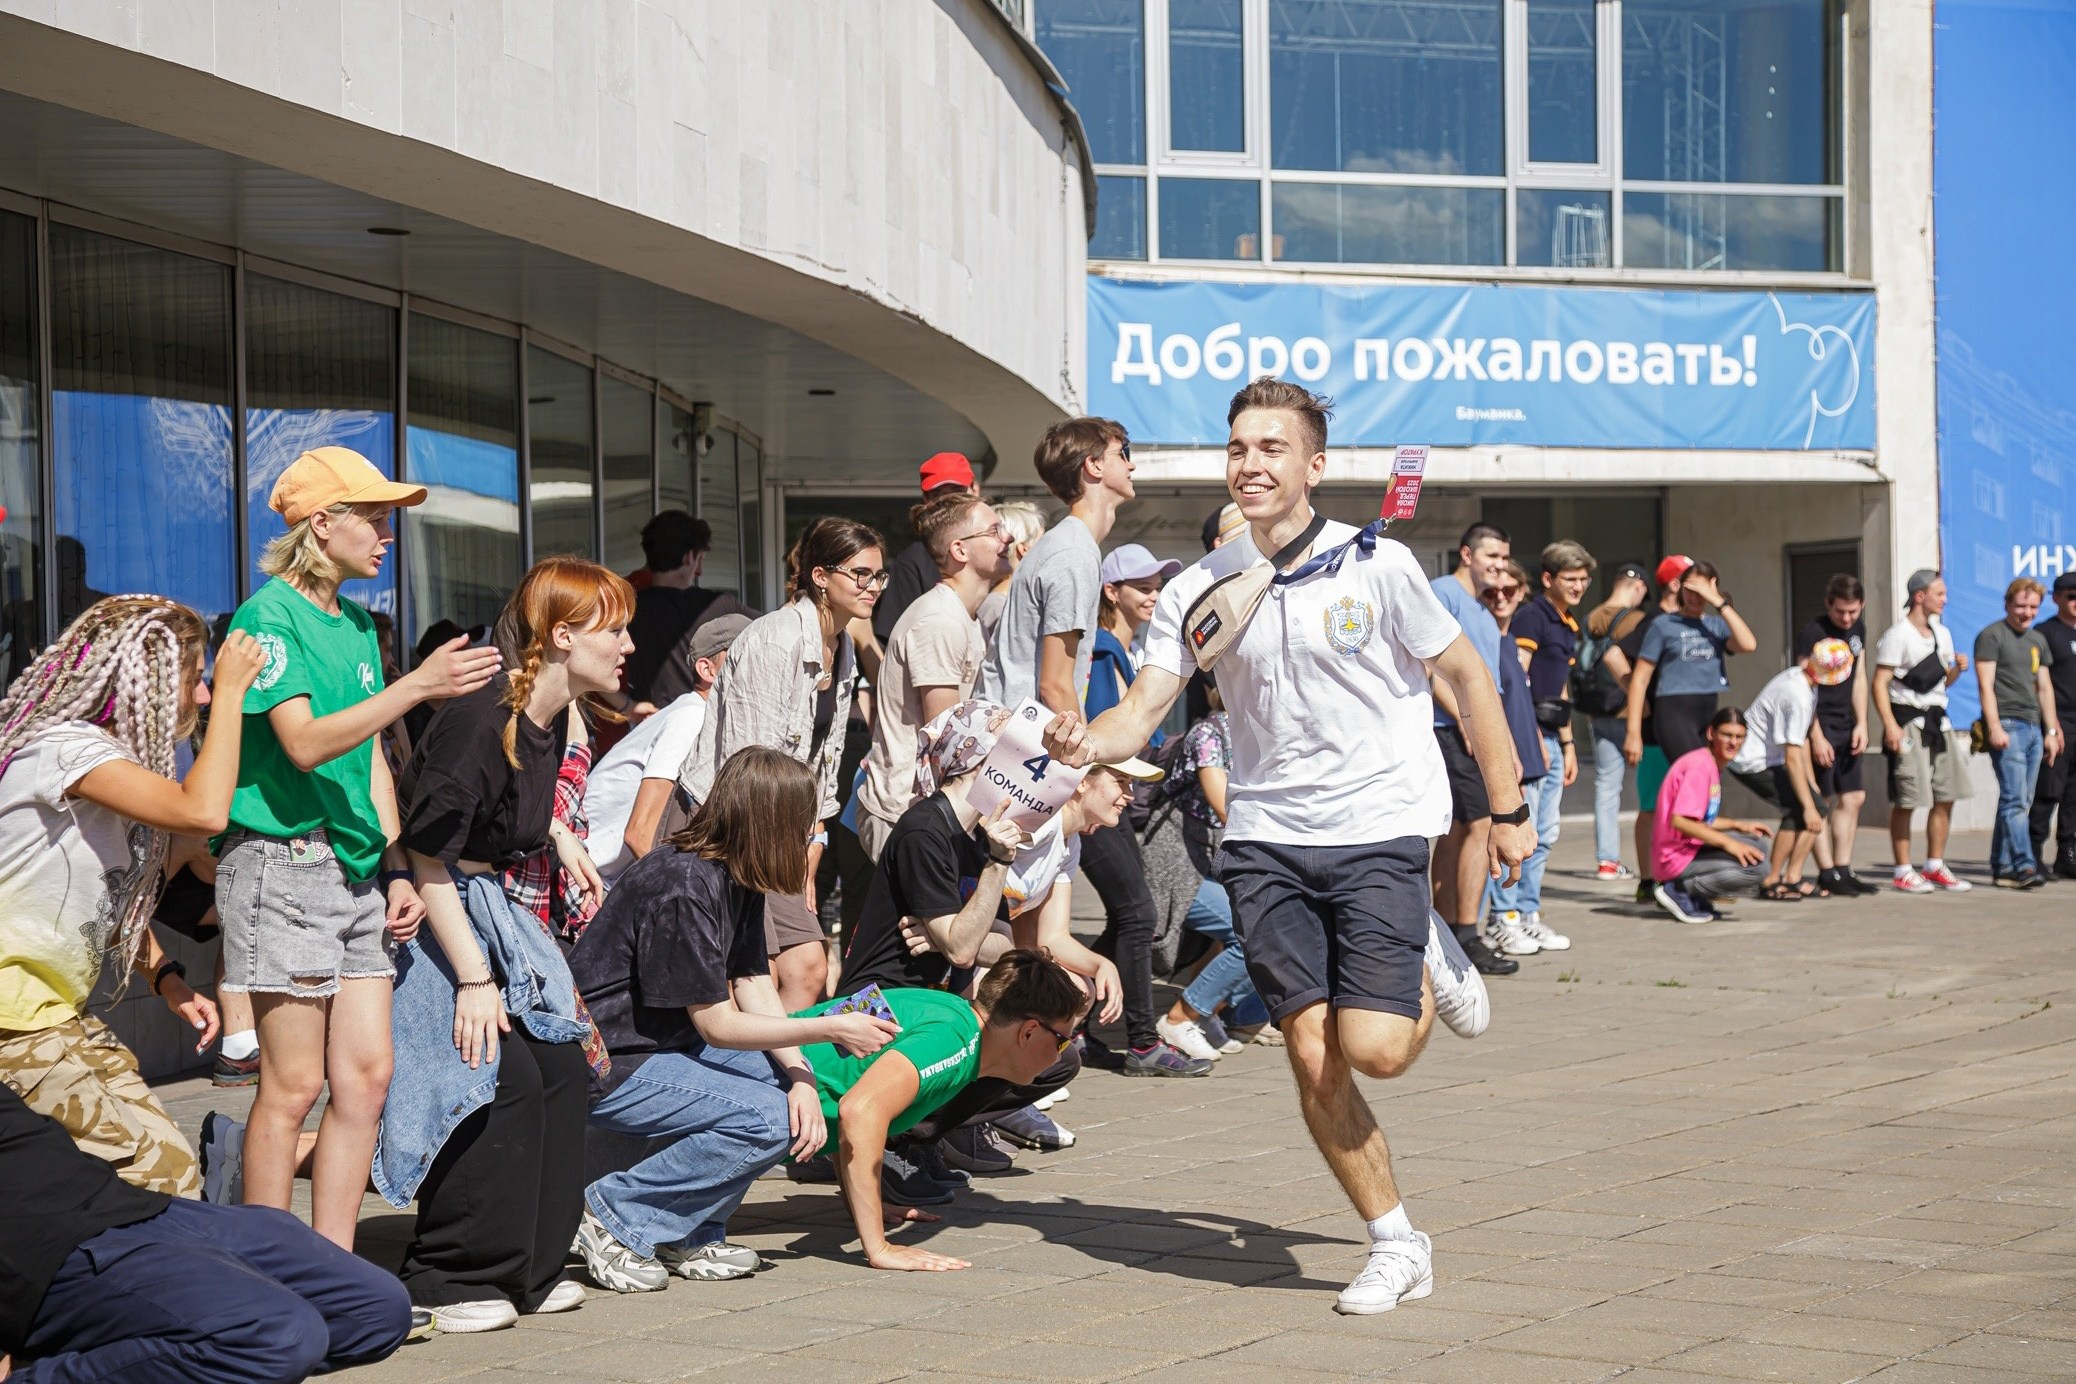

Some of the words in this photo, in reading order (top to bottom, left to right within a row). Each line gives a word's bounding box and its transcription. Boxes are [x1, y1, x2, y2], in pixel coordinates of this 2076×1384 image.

[1111, 322, 1332, 386] Добро
[1354, 334, 1758, 388] пожаловать!
[984, 765, 1054, 816] КОМАНДА
[1022, 753, 1051, 784] 4
